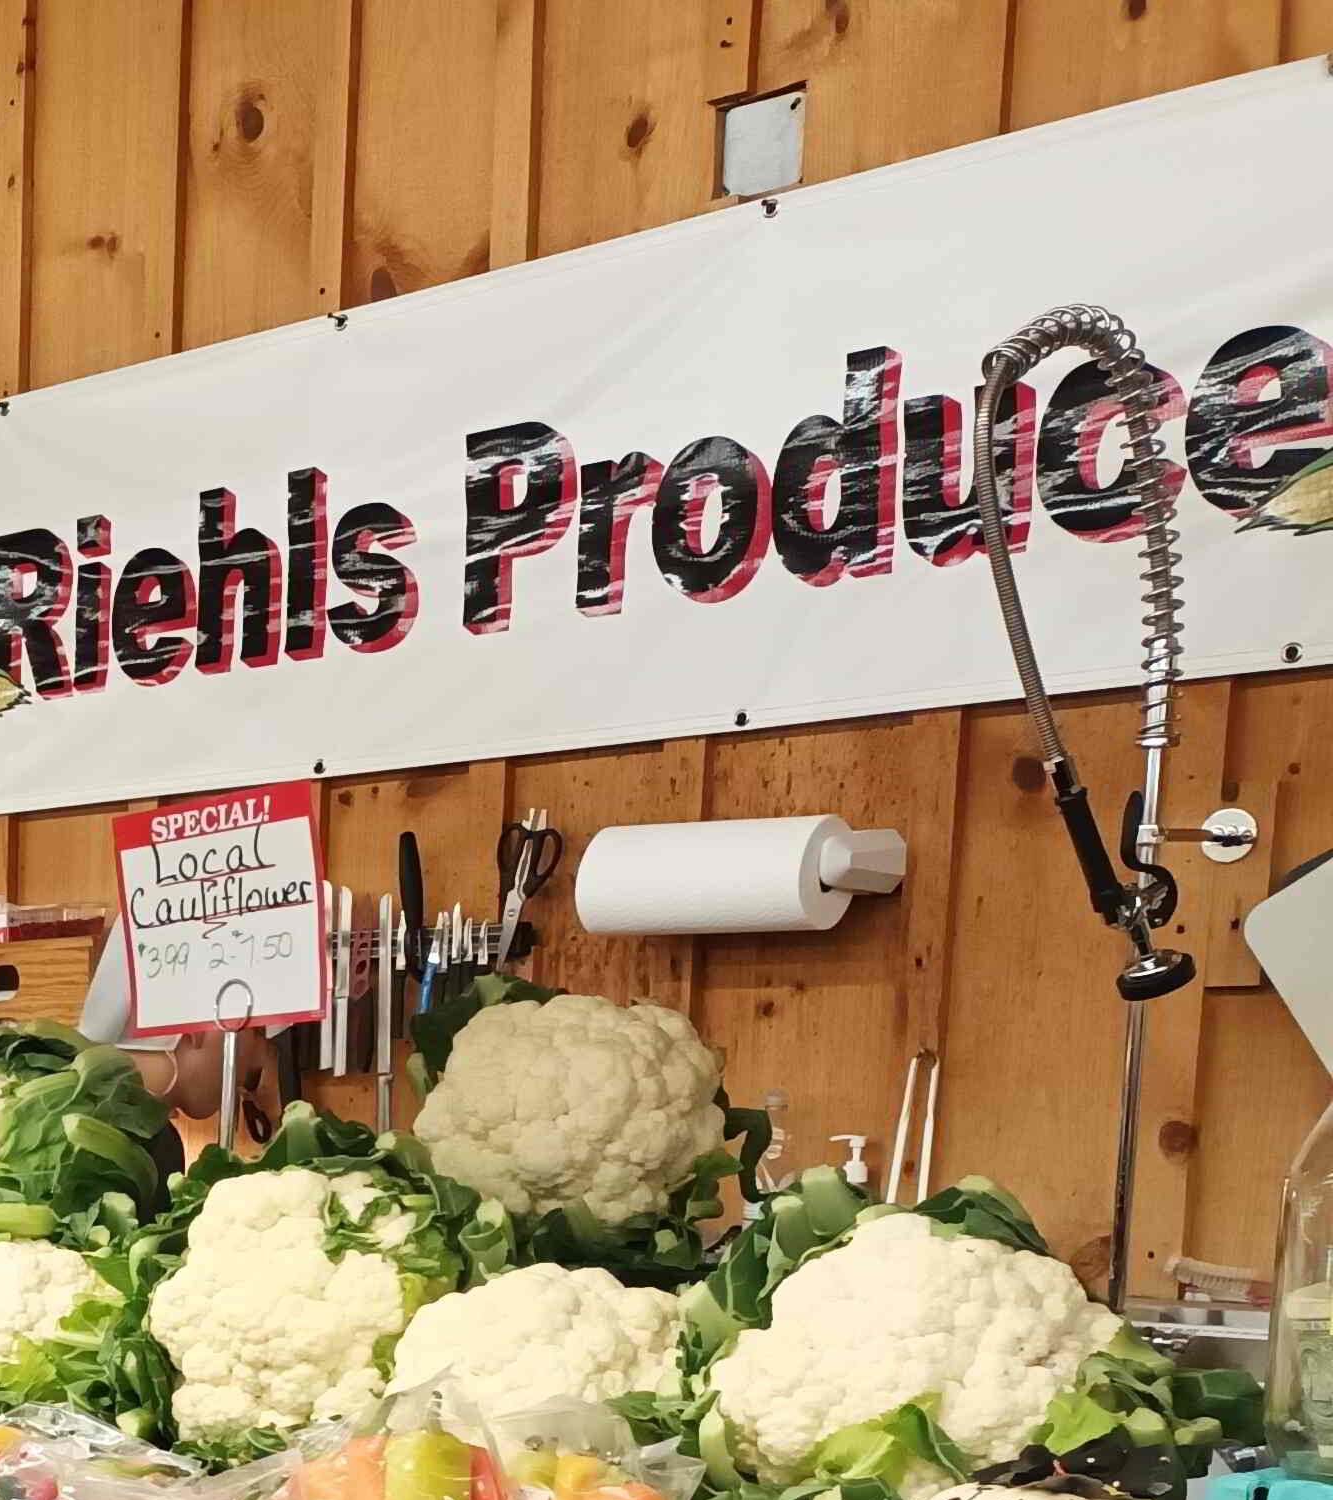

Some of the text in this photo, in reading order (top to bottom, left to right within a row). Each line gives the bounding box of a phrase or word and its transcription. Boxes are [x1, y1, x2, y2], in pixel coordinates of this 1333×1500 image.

[463, 325, 1333, 637] Produce
[151, 795, 272, 843] SPECIAL!
[151, 824, 273, 885] Local
[130, 875, 313, 929] Cauliflower
